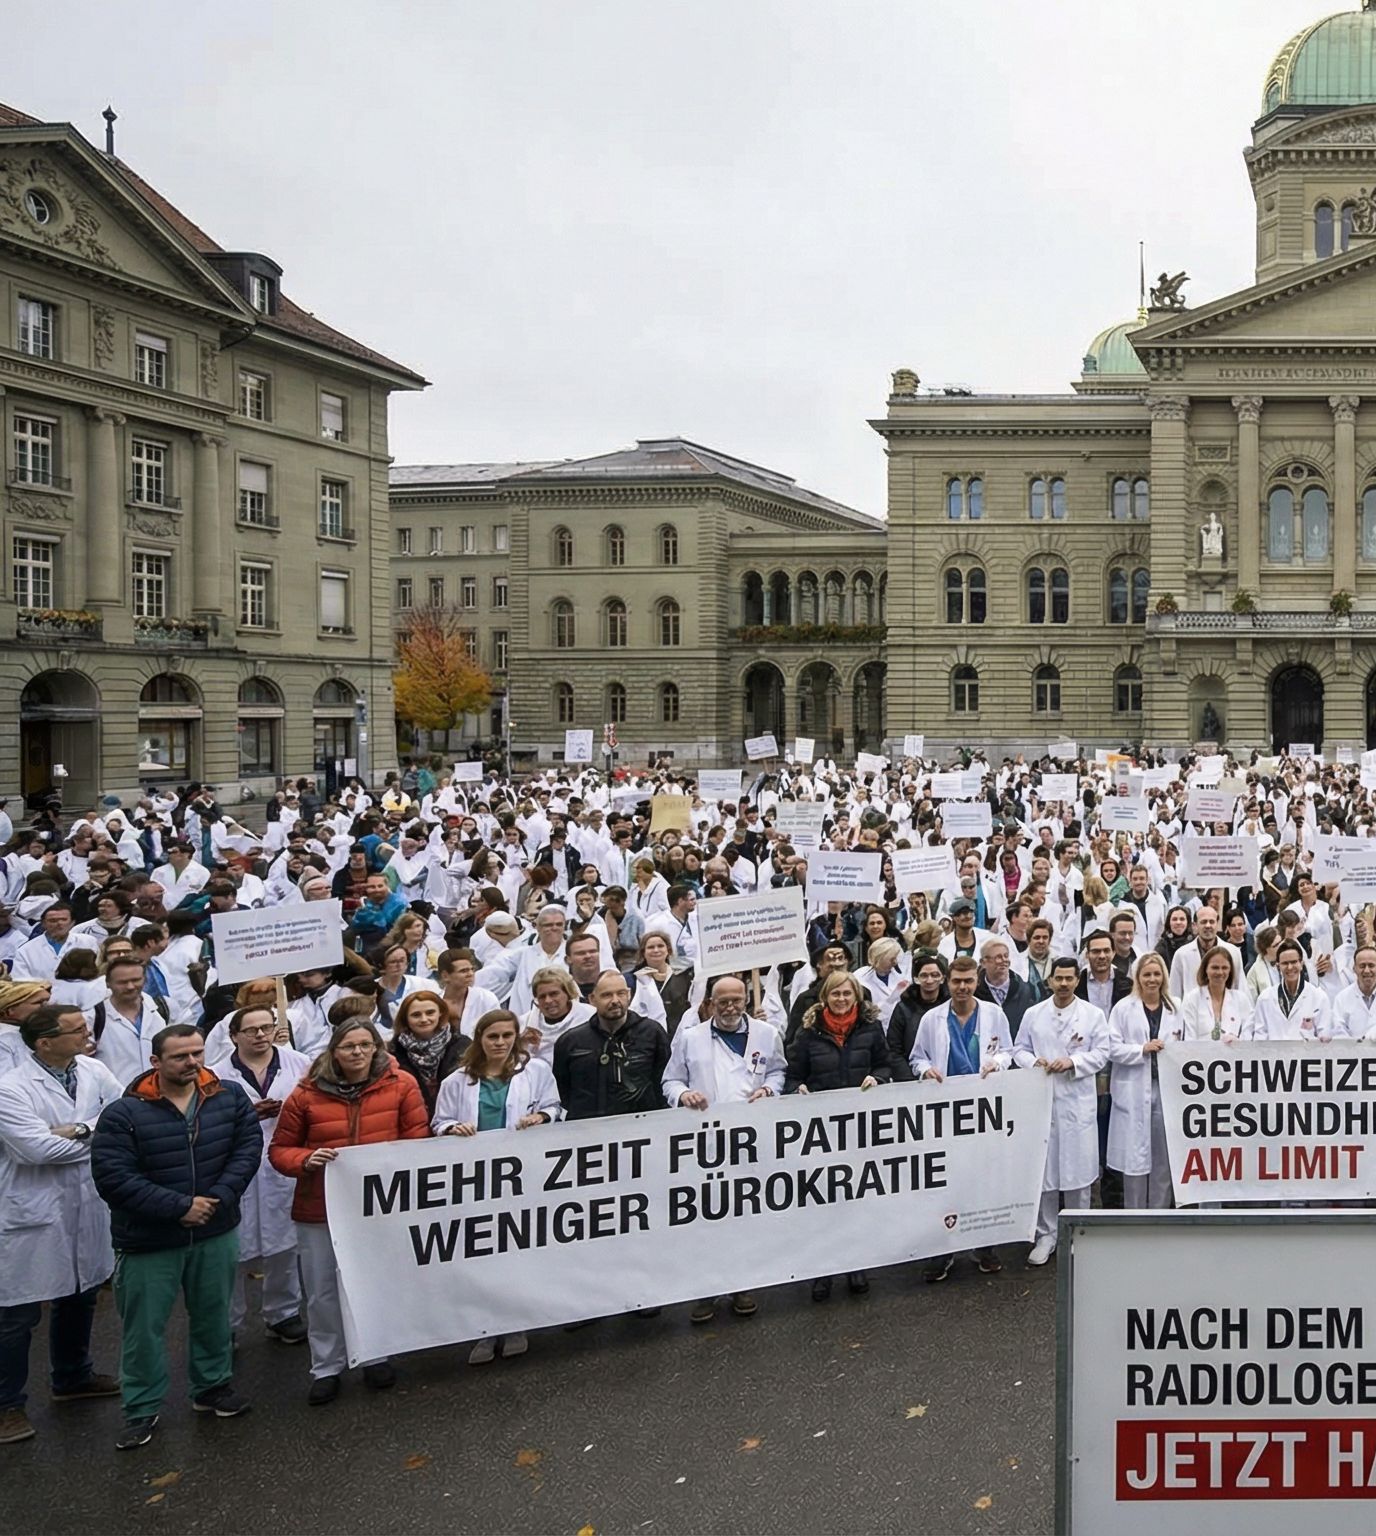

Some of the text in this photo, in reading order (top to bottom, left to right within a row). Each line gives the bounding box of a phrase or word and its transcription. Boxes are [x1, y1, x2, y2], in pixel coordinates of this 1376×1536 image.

[363, 1095, 1014, 1217] MEHR ZEIT FÜR PATIENTEN,
[1181, 1145, 1365, 1184] AM LIMIT
[408, 1193, 650, 1266] WENIGER
[668, 1151, 947, 1227] BÜROKRATIE
[1126, 1307, 1363, 1351] NACH DEM
[1126, 1431, 1307, 1489] JETZT
